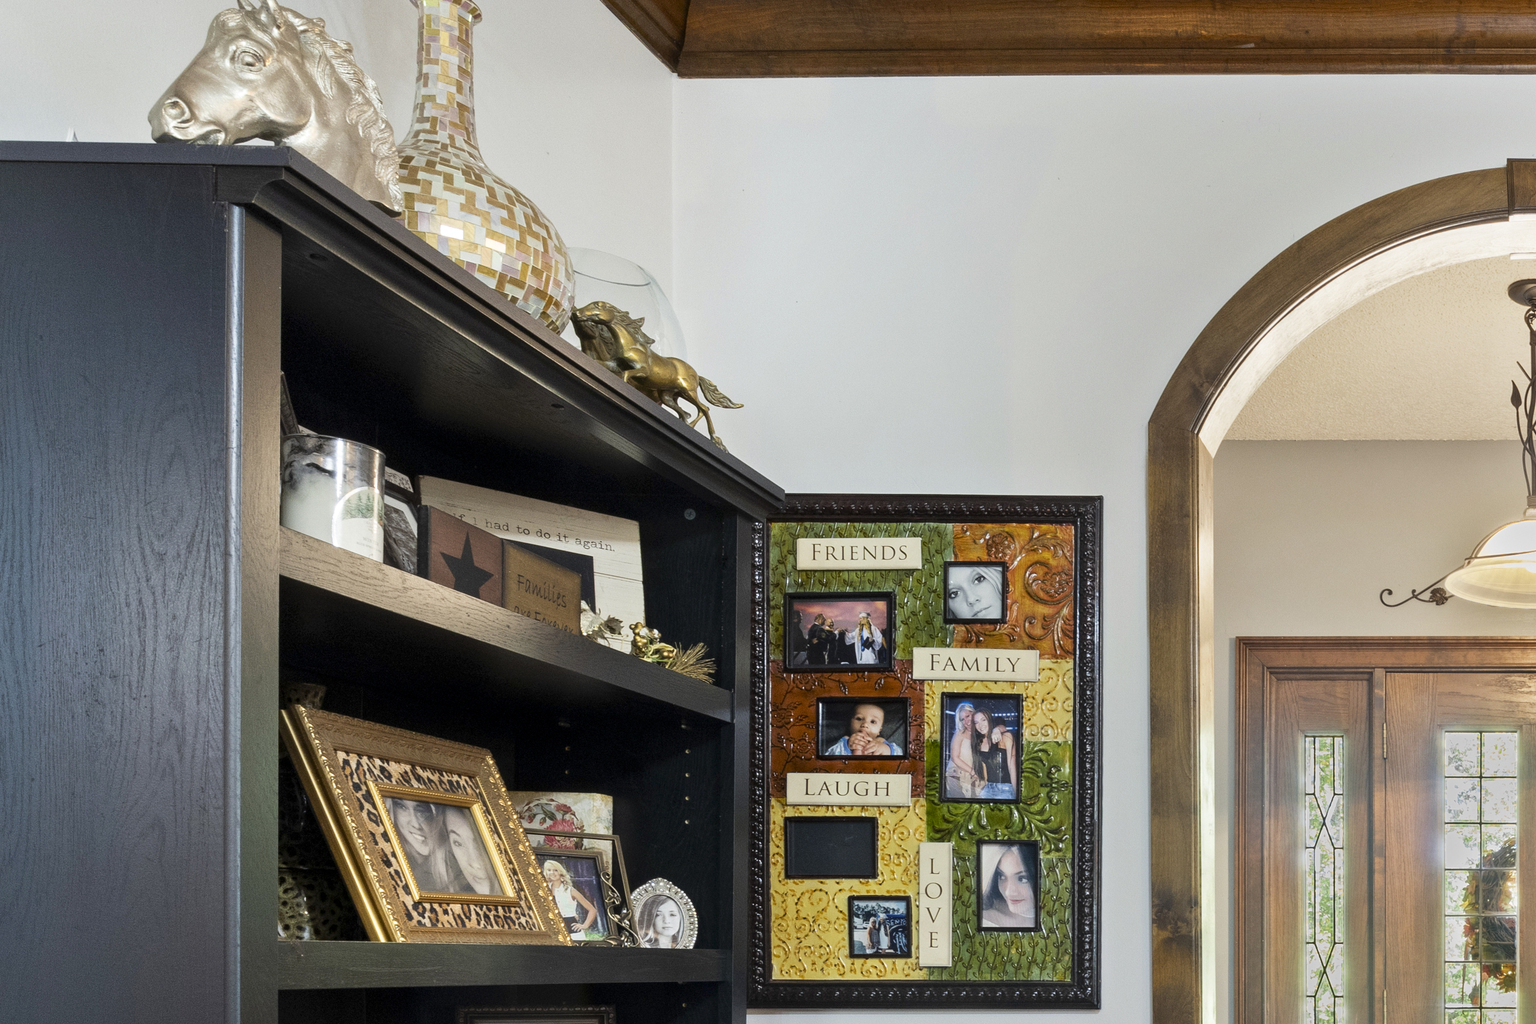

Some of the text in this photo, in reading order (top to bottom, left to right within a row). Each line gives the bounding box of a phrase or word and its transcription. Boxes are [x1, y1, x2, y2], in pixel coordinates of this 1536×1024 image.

[485, 519, 510, 532] had
[516, 525, 531, 536] to
[535, 528, 551, 540] do
[556, 530, 570, 543] it
[575, 537, 616, 552] again.
[811, 543, 908, 562] FRIENDS
[517, 573, 567, 608] Families
[929, 653, 1022, 674] FAMILY
[804, 778, 891, 797] LAUGH
[923, 858, 943, 949] LOVE
